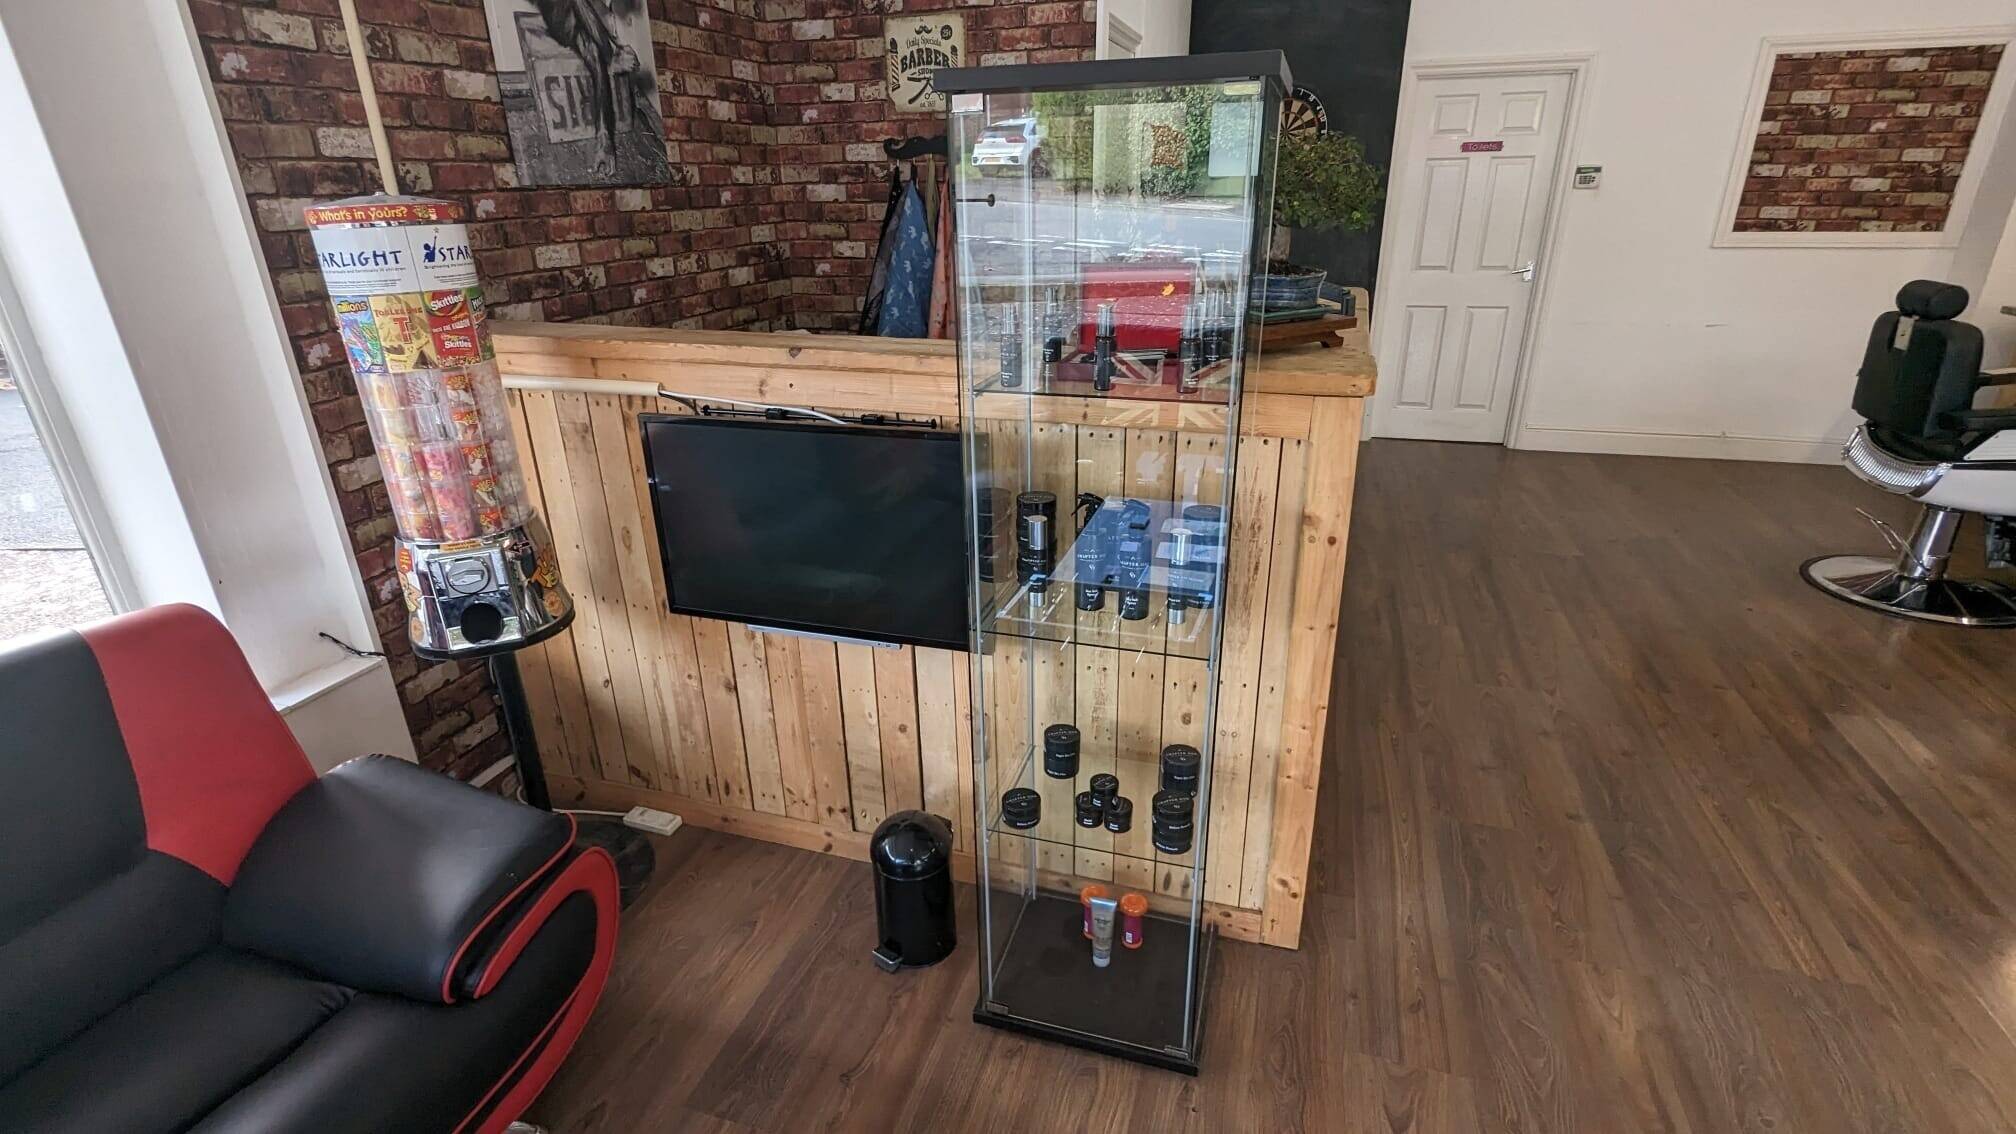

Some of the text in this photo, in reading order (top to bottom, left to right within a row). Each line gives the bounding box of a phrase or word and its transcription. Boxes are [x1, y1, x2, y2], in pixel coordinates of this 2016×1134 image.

[900, 48, 950, 73] BARBER
[318, 206, 408, 222] What's in yours?
[431, 294, 464, 311] Skittles
[444, 340, 472, 349] Skittles
